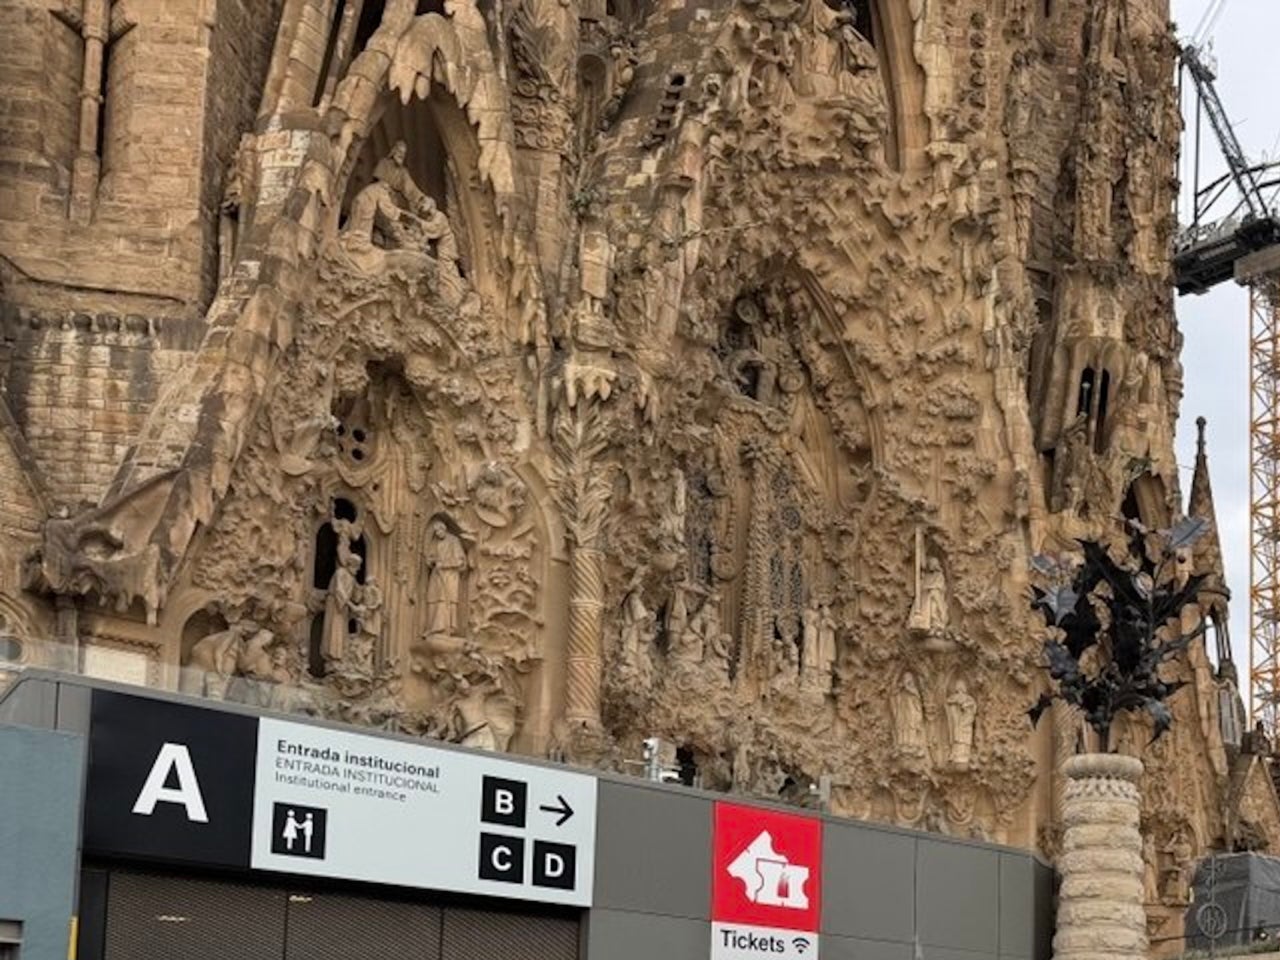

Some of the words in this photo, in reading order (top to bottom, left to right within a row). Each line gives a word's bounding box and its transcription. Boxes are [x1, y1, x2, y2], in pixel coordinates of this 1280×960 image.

[277, 739, 340, 762] Entrada
[345, 750, 440, 778] institucional
[131, 742, 209, 823] A
[275, 757, 340, 777] ENTRADA
[343, 769, 440, 793] INSTITUCIONAL
[275, 771, 350, 793] Institutional
[354, 786, 407, 802] entrance
[495, 789, 514, 814] B
[491, 845, 512, 871] C
[545, 852, 565, 877] D
[720, 929, 785, 953] Tickets
